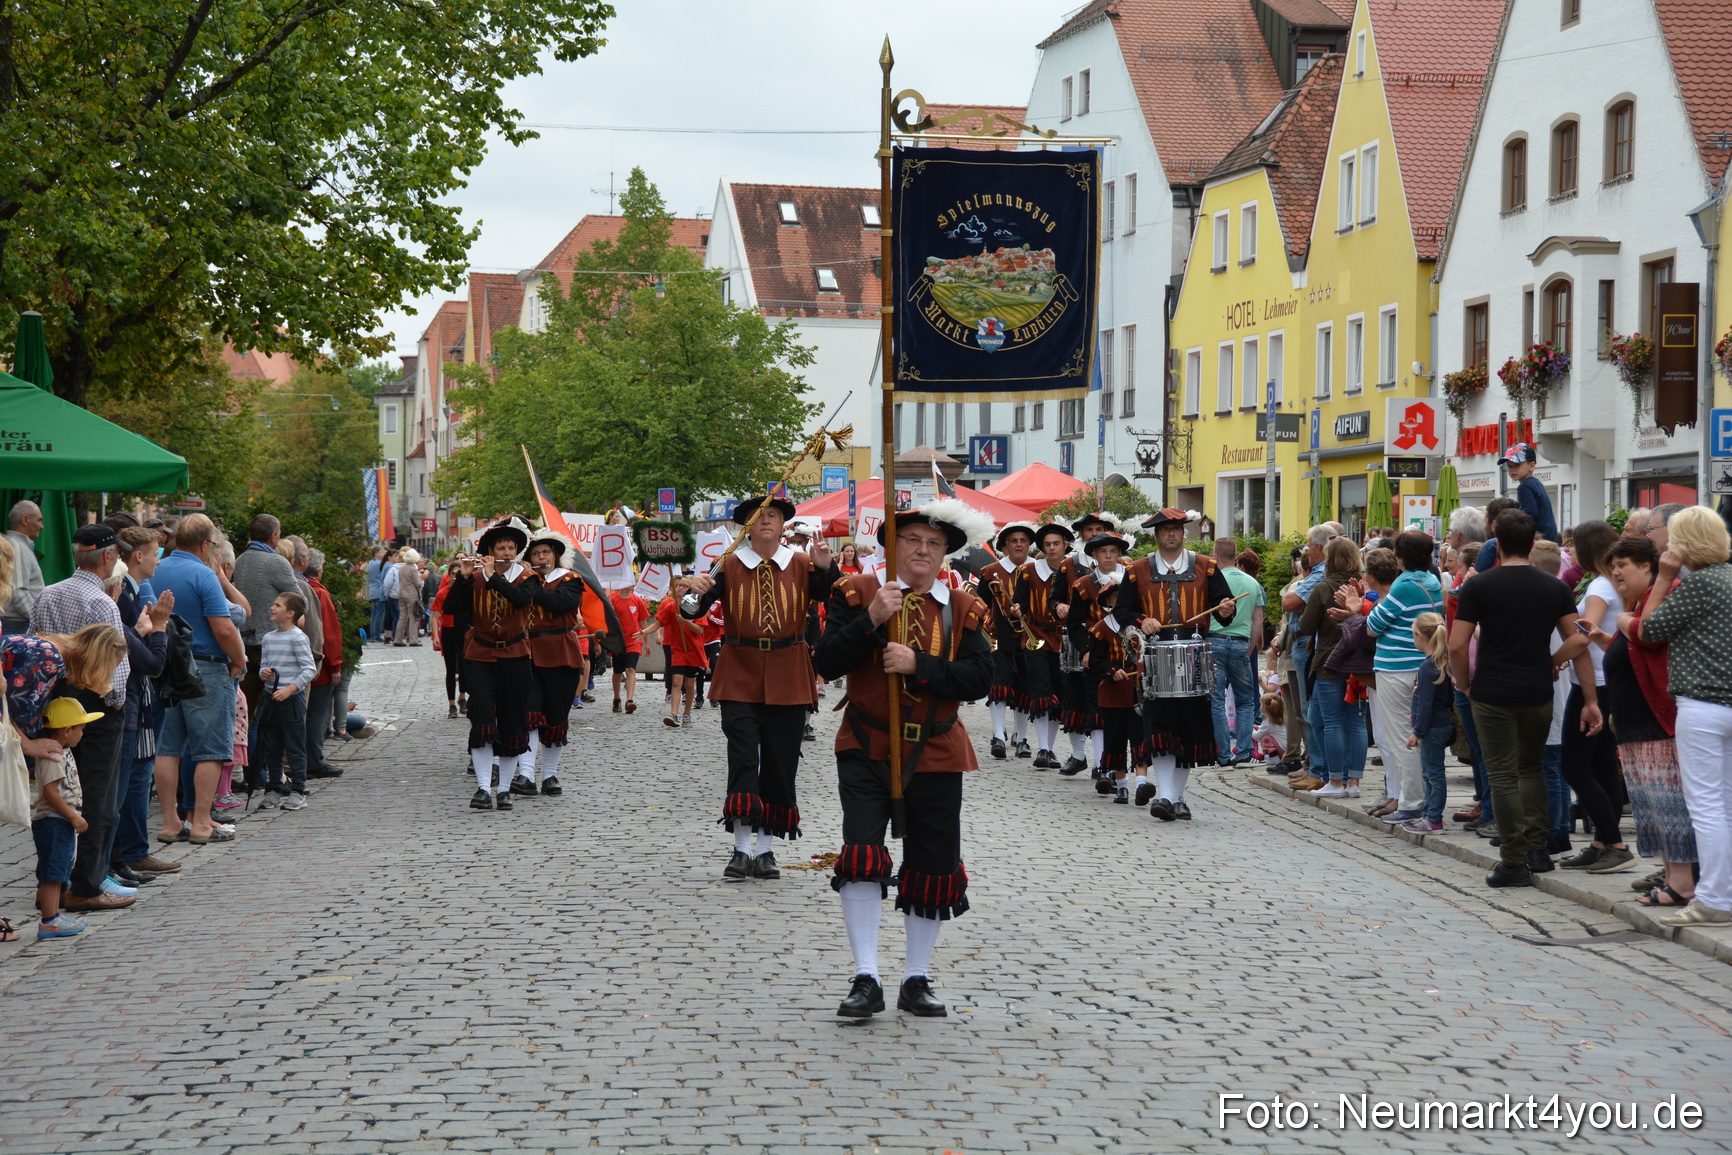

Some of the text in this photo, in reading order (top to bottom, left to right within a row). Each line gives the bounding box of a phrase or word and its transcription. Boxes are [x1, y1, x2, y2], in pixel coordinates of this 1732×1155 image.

[937, 193, 1057, 233] Spielmannszug
[924, 300, 970, 342] Markt
[1012, 300, 1065, 342] Lupburg
[1226, 294, 1298, 331] HOTEL Lehmeier
[0, 430, 31, 439] ter
[1311, 415, 1318, 445] P
[1331, 415, 1362, 436] TAIFUN
[1718, 415, 1732, 451] P
[1221, 444, 1264, 464] Restaurant
[1391, 460, 1418, 472] 15:21
[424, 520, 433, 530] T
[648, 529, 679, 542] BSC
[601, 534, 625, 567] B
